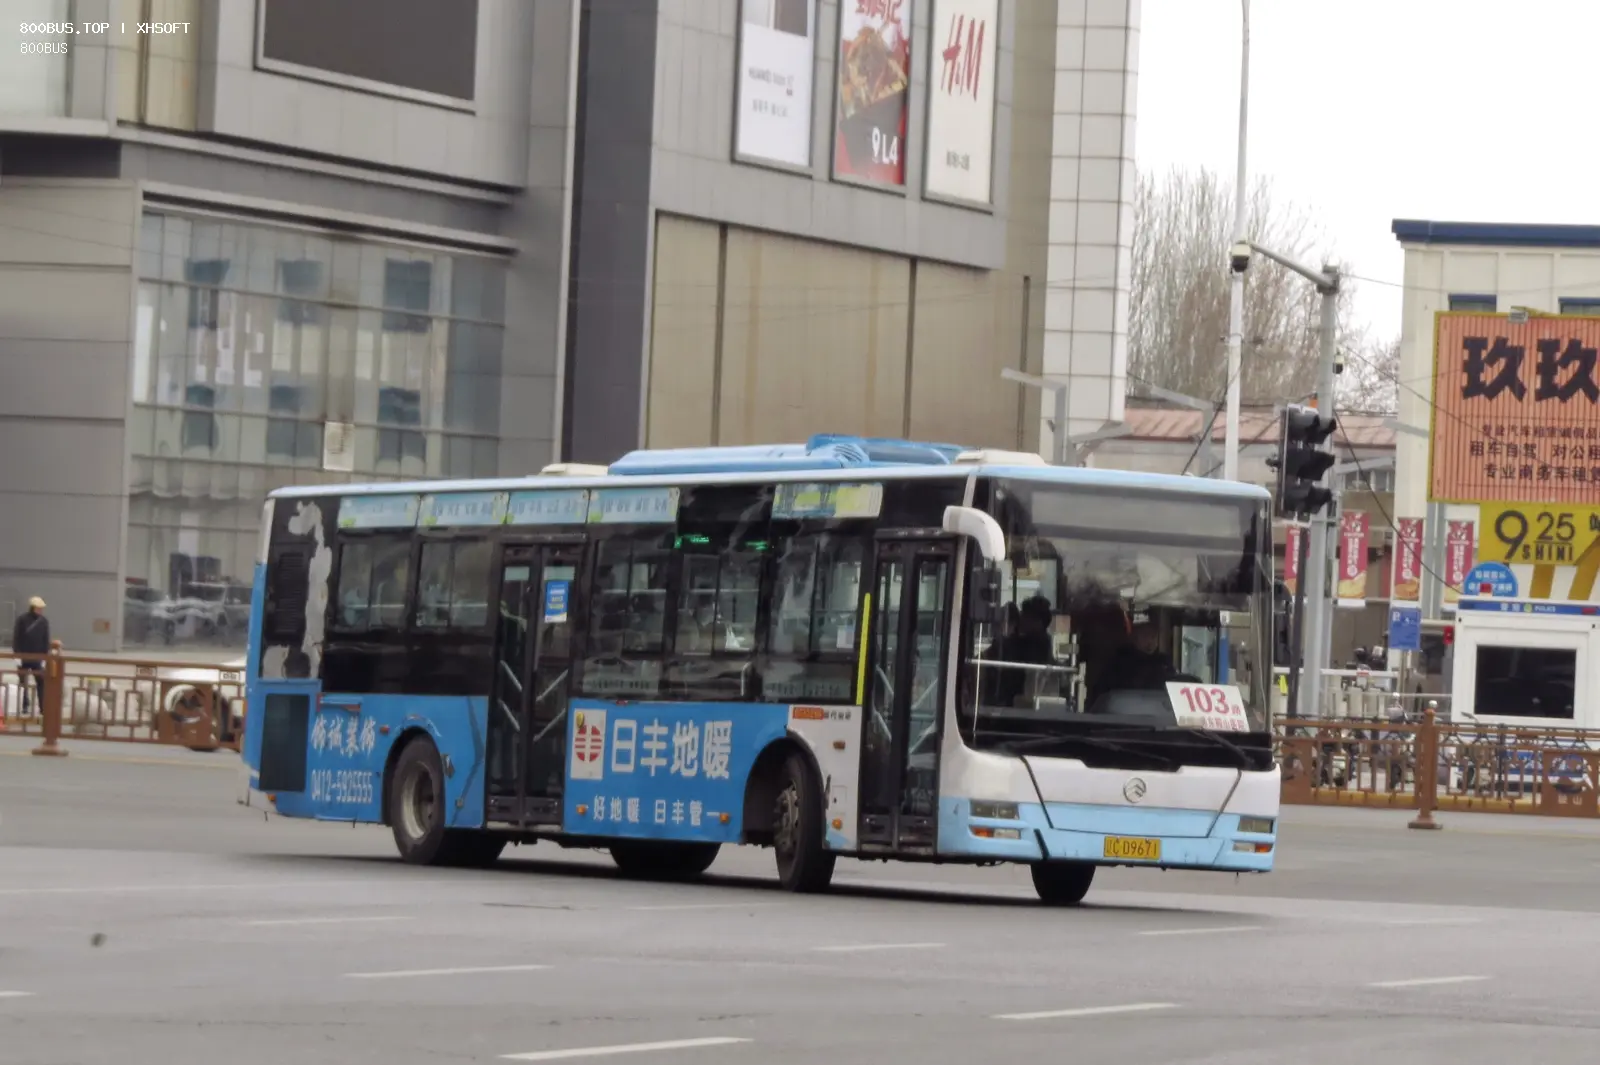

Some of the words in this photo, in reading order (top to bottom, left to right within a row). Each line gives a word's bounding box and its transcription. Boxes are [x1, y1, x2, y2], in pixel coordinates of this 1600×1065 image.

[882, 133, 898, 166] L4
[1461, 335, 1600, 404] 玖玖
[1536, 512, 1576, 541] 25
[611, 718, 732, 780] 日丰地暖
[593, 795, 640, 823] 好地暖
[654, 799, 703, 827] 日丰管
